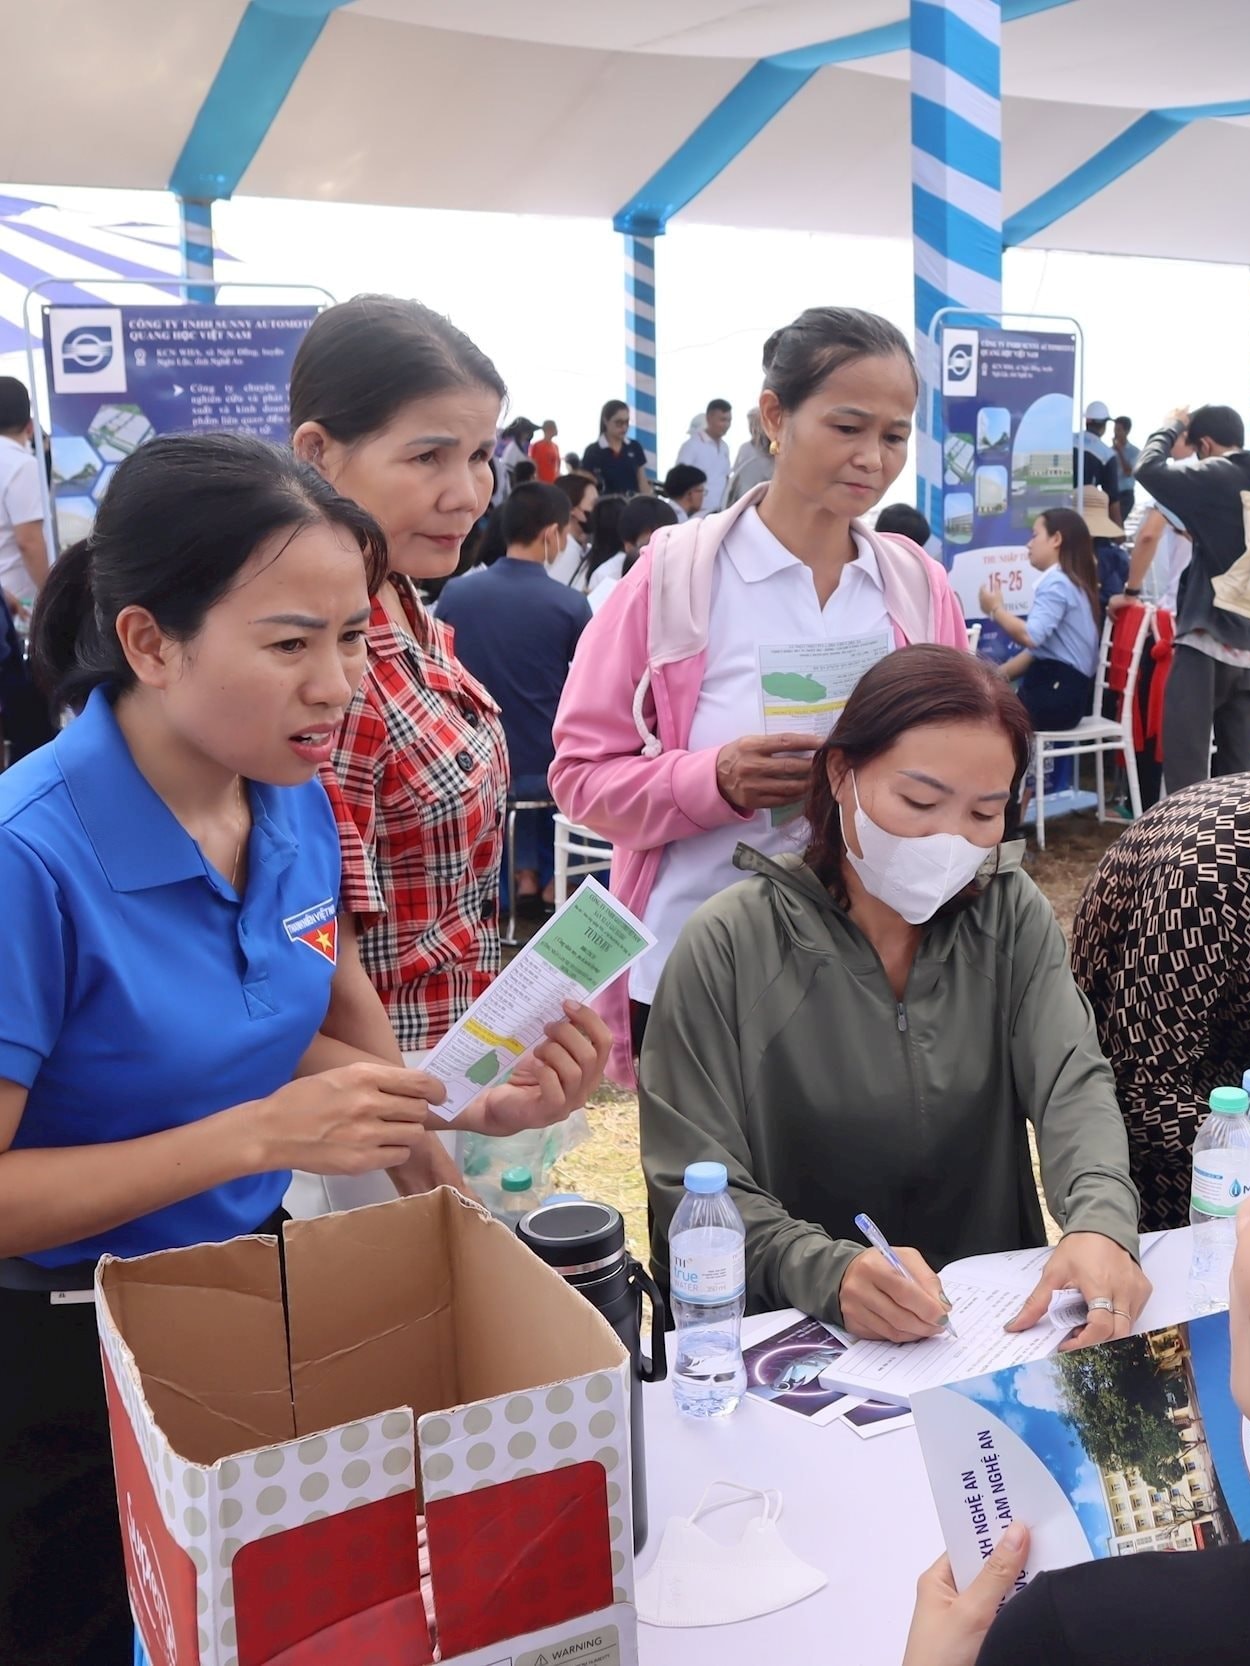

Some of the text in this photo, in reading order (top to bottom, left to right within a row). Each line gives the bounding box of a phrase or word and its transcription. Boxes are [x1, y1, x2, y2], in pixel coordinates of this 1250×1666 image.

[129, 318, 161, 330] CÔNG
[165, 319, 178, 329] TY
[183, 319, 213, 329] TNHH
[215, 319, 252, 329] SUNNY
[129, 328, 252, 341] QUANG HỌC VIỆT NAM
[225, 384, 233, 393] ty
[674, 1255, 686, 1268] TH
[674, 1265, 698, 1283] true
[674, 1281, 699, 1292] WATER
[977, 1430, 995, 1450] AN
[961, 1470, 978, 1490] AN
[981, 1453, 1006, 1495] NGHỆ
[964, 1493, 992, 1536] NGHỆ
[552, 1636, 602, 1661] WARNING
